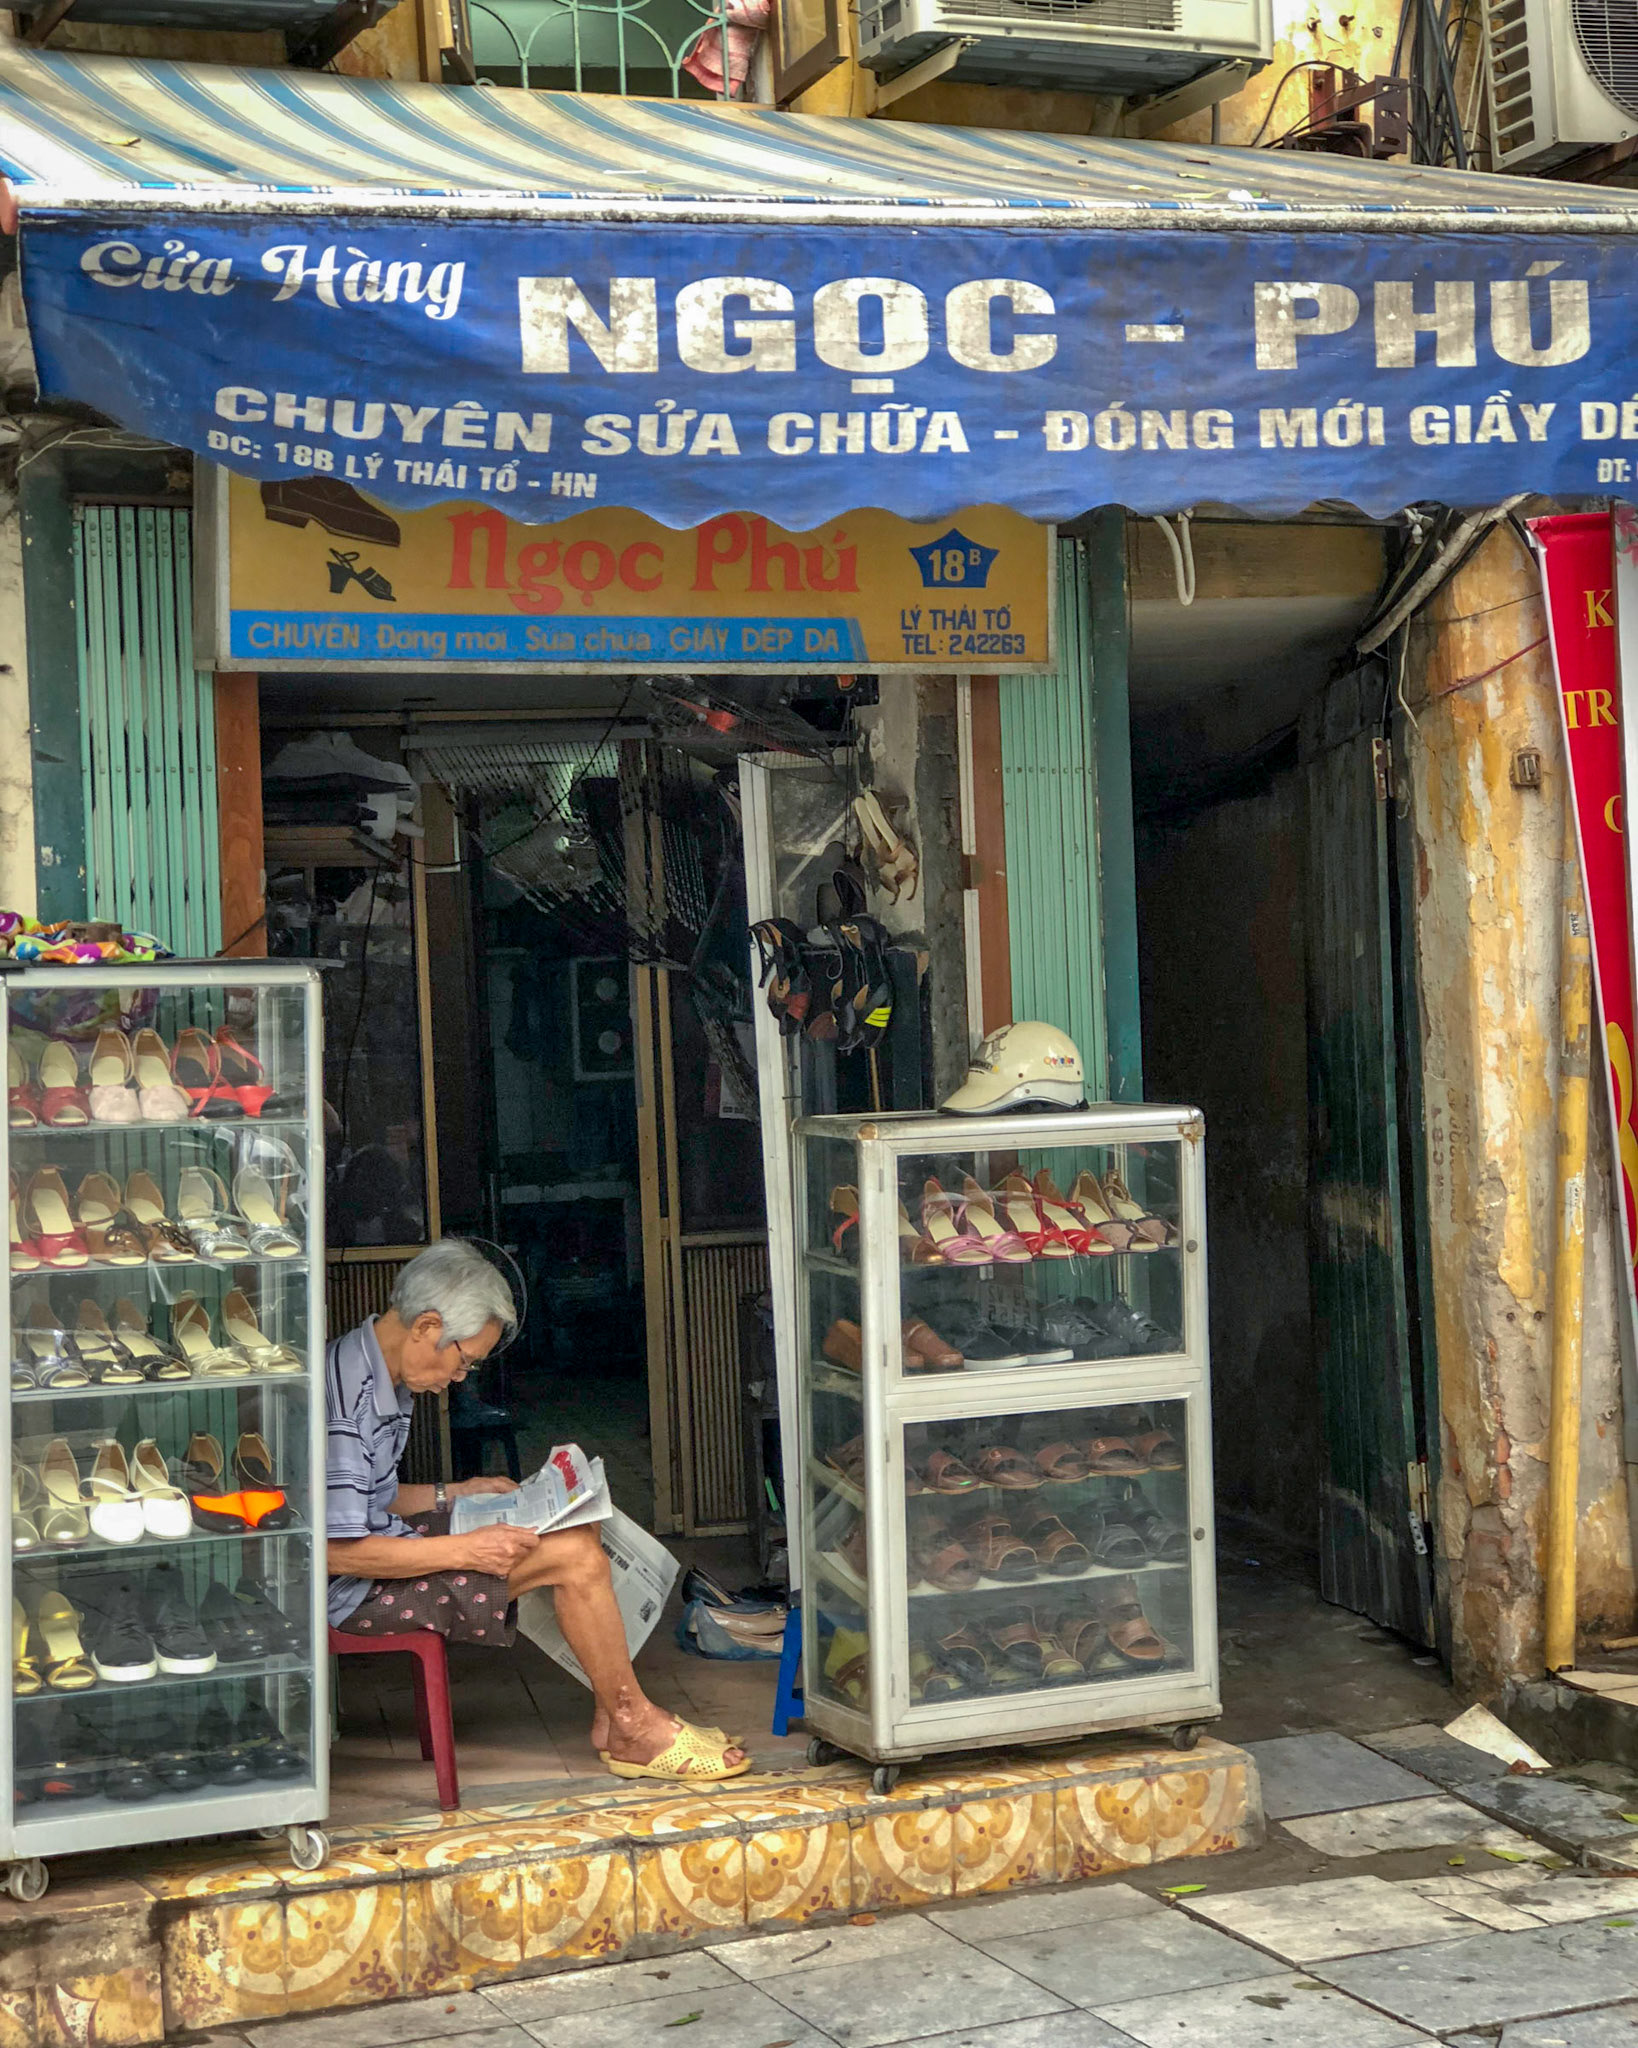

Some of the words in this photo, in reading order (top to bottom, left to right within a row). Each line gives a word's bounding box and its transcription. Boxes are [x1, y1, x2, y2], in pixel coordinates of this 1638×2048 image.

[80, 239, 240, 296] Cửa
[260, 243, 466, 321] Hàng
[517, 274, 1058, 394] NGỌC
[1253, 260, 1592, 370] PHÚ
[214, 385, 554, 454] CHUYÊN
[580, 398, 742, 457] SỬA
[767, 402, 971, 455] CHỮA
[1041, 400, 1236, 452] ĐÓNG
[1258, 397, 1387, 449] MỚI
[1409, 389, 1557, 446] GIẦY
[206, 429, 262, 460] ĐC:
[273, 441, 335, 472] 18B
[345, 451, 384, 480] LÝ
[393, 458, 467, 490] THÁI
[478, 459, 521, 493] TỔ
[550, 470, 598, 499] HN
[690, 512, 861, 594] Phú
[803, 627, 840, 654] DA
[900, 603, 922, 631] LÝ
[928, 603, 977, 631] THÁI
[948, 633, 1026, 656] 242263
